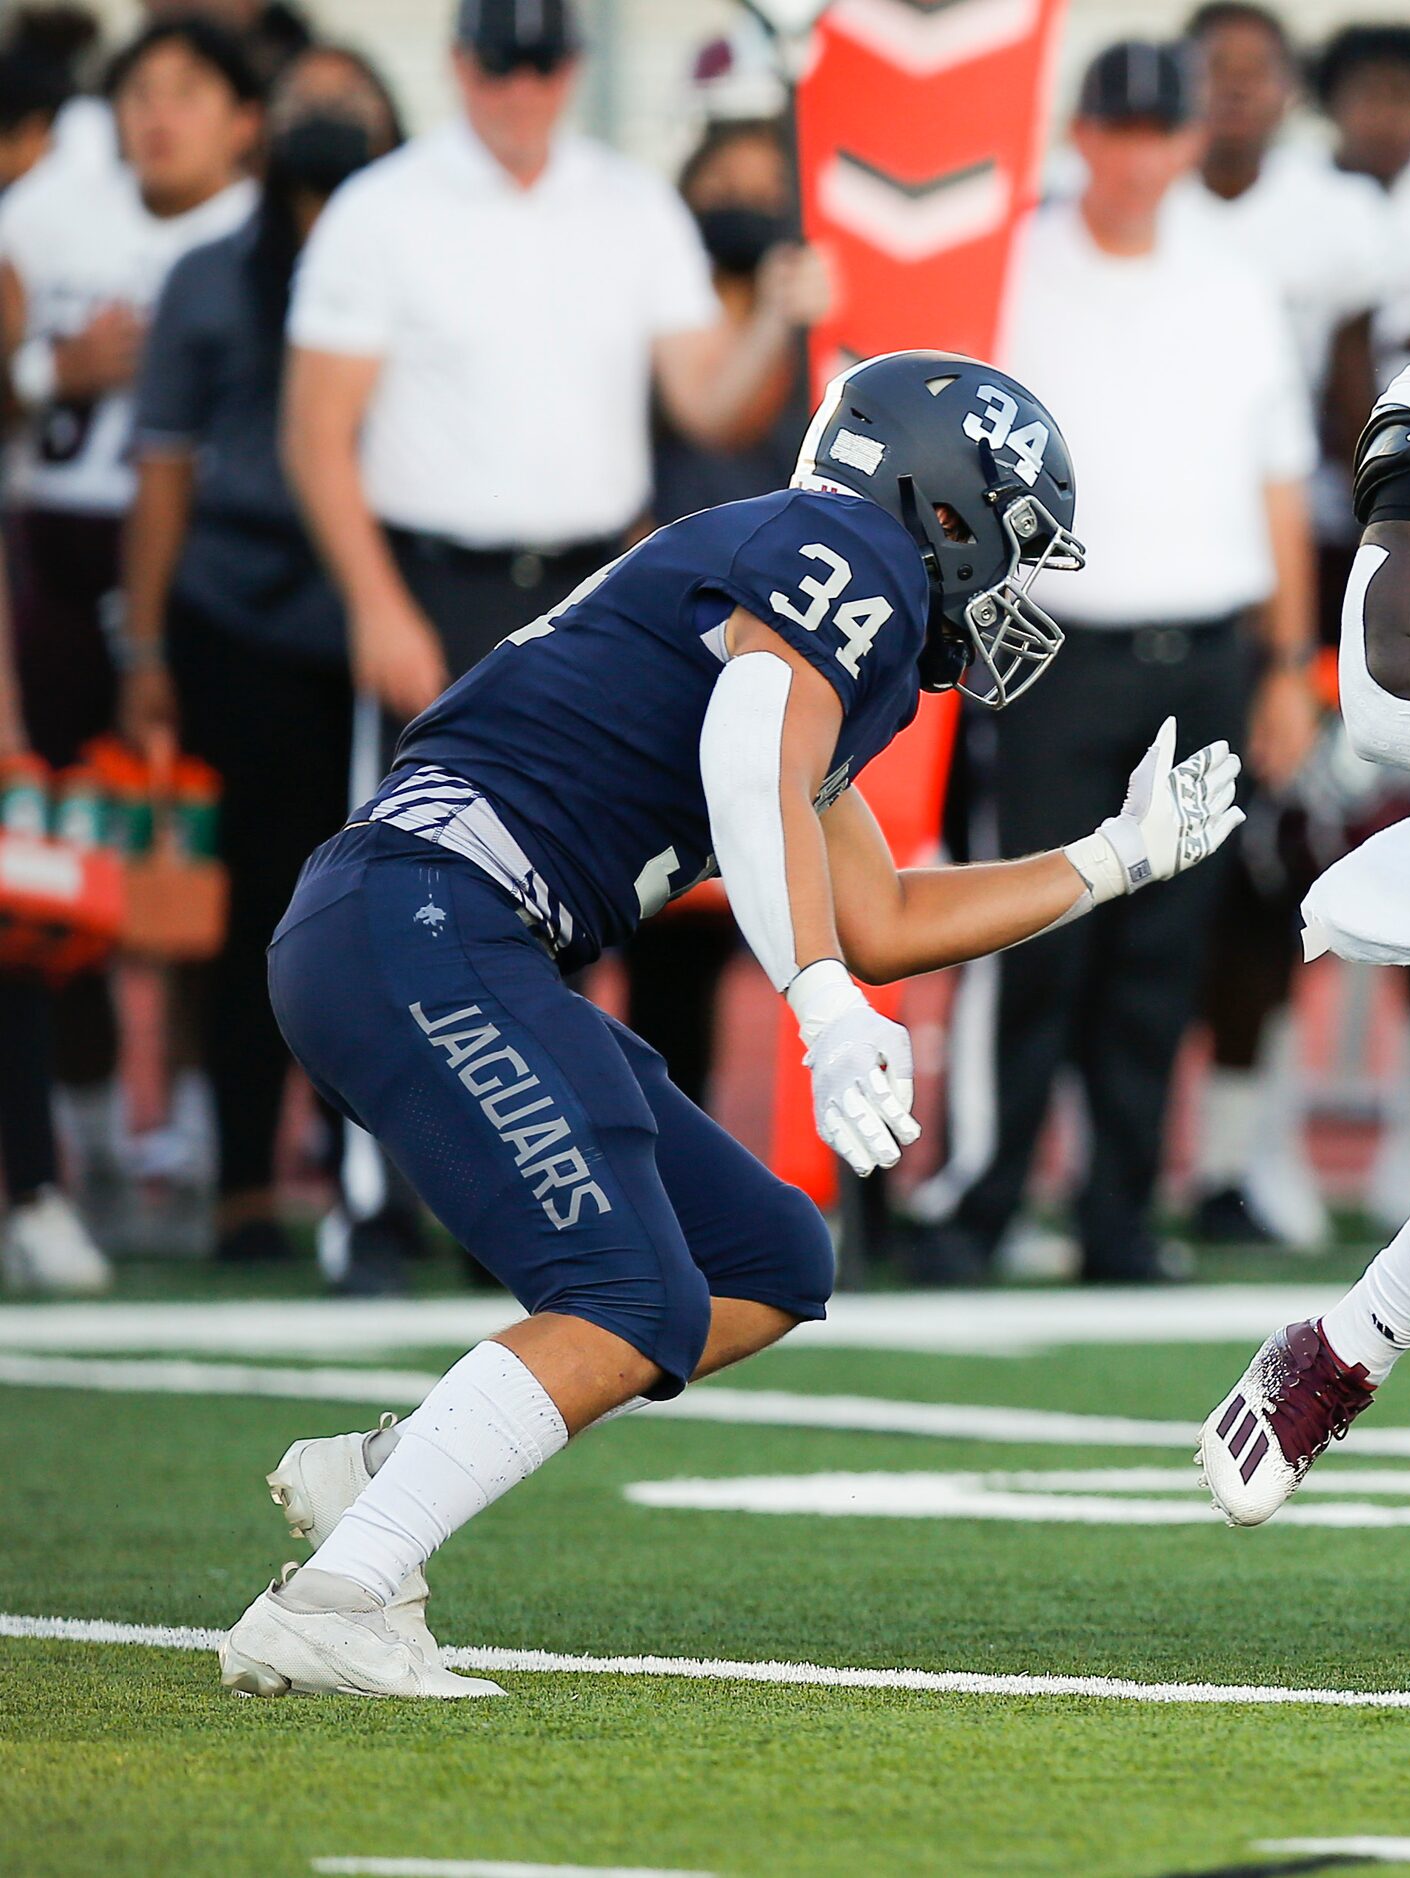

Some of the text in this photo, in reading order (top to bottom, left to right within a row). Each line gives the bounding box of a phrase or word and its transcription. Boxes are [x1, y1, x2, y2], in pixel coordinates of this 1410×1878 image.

[961, 384, 1049, 488] 34
[769, 543, 894, 679] 34
[408, 1001, 612, 1231] JAGUARS
